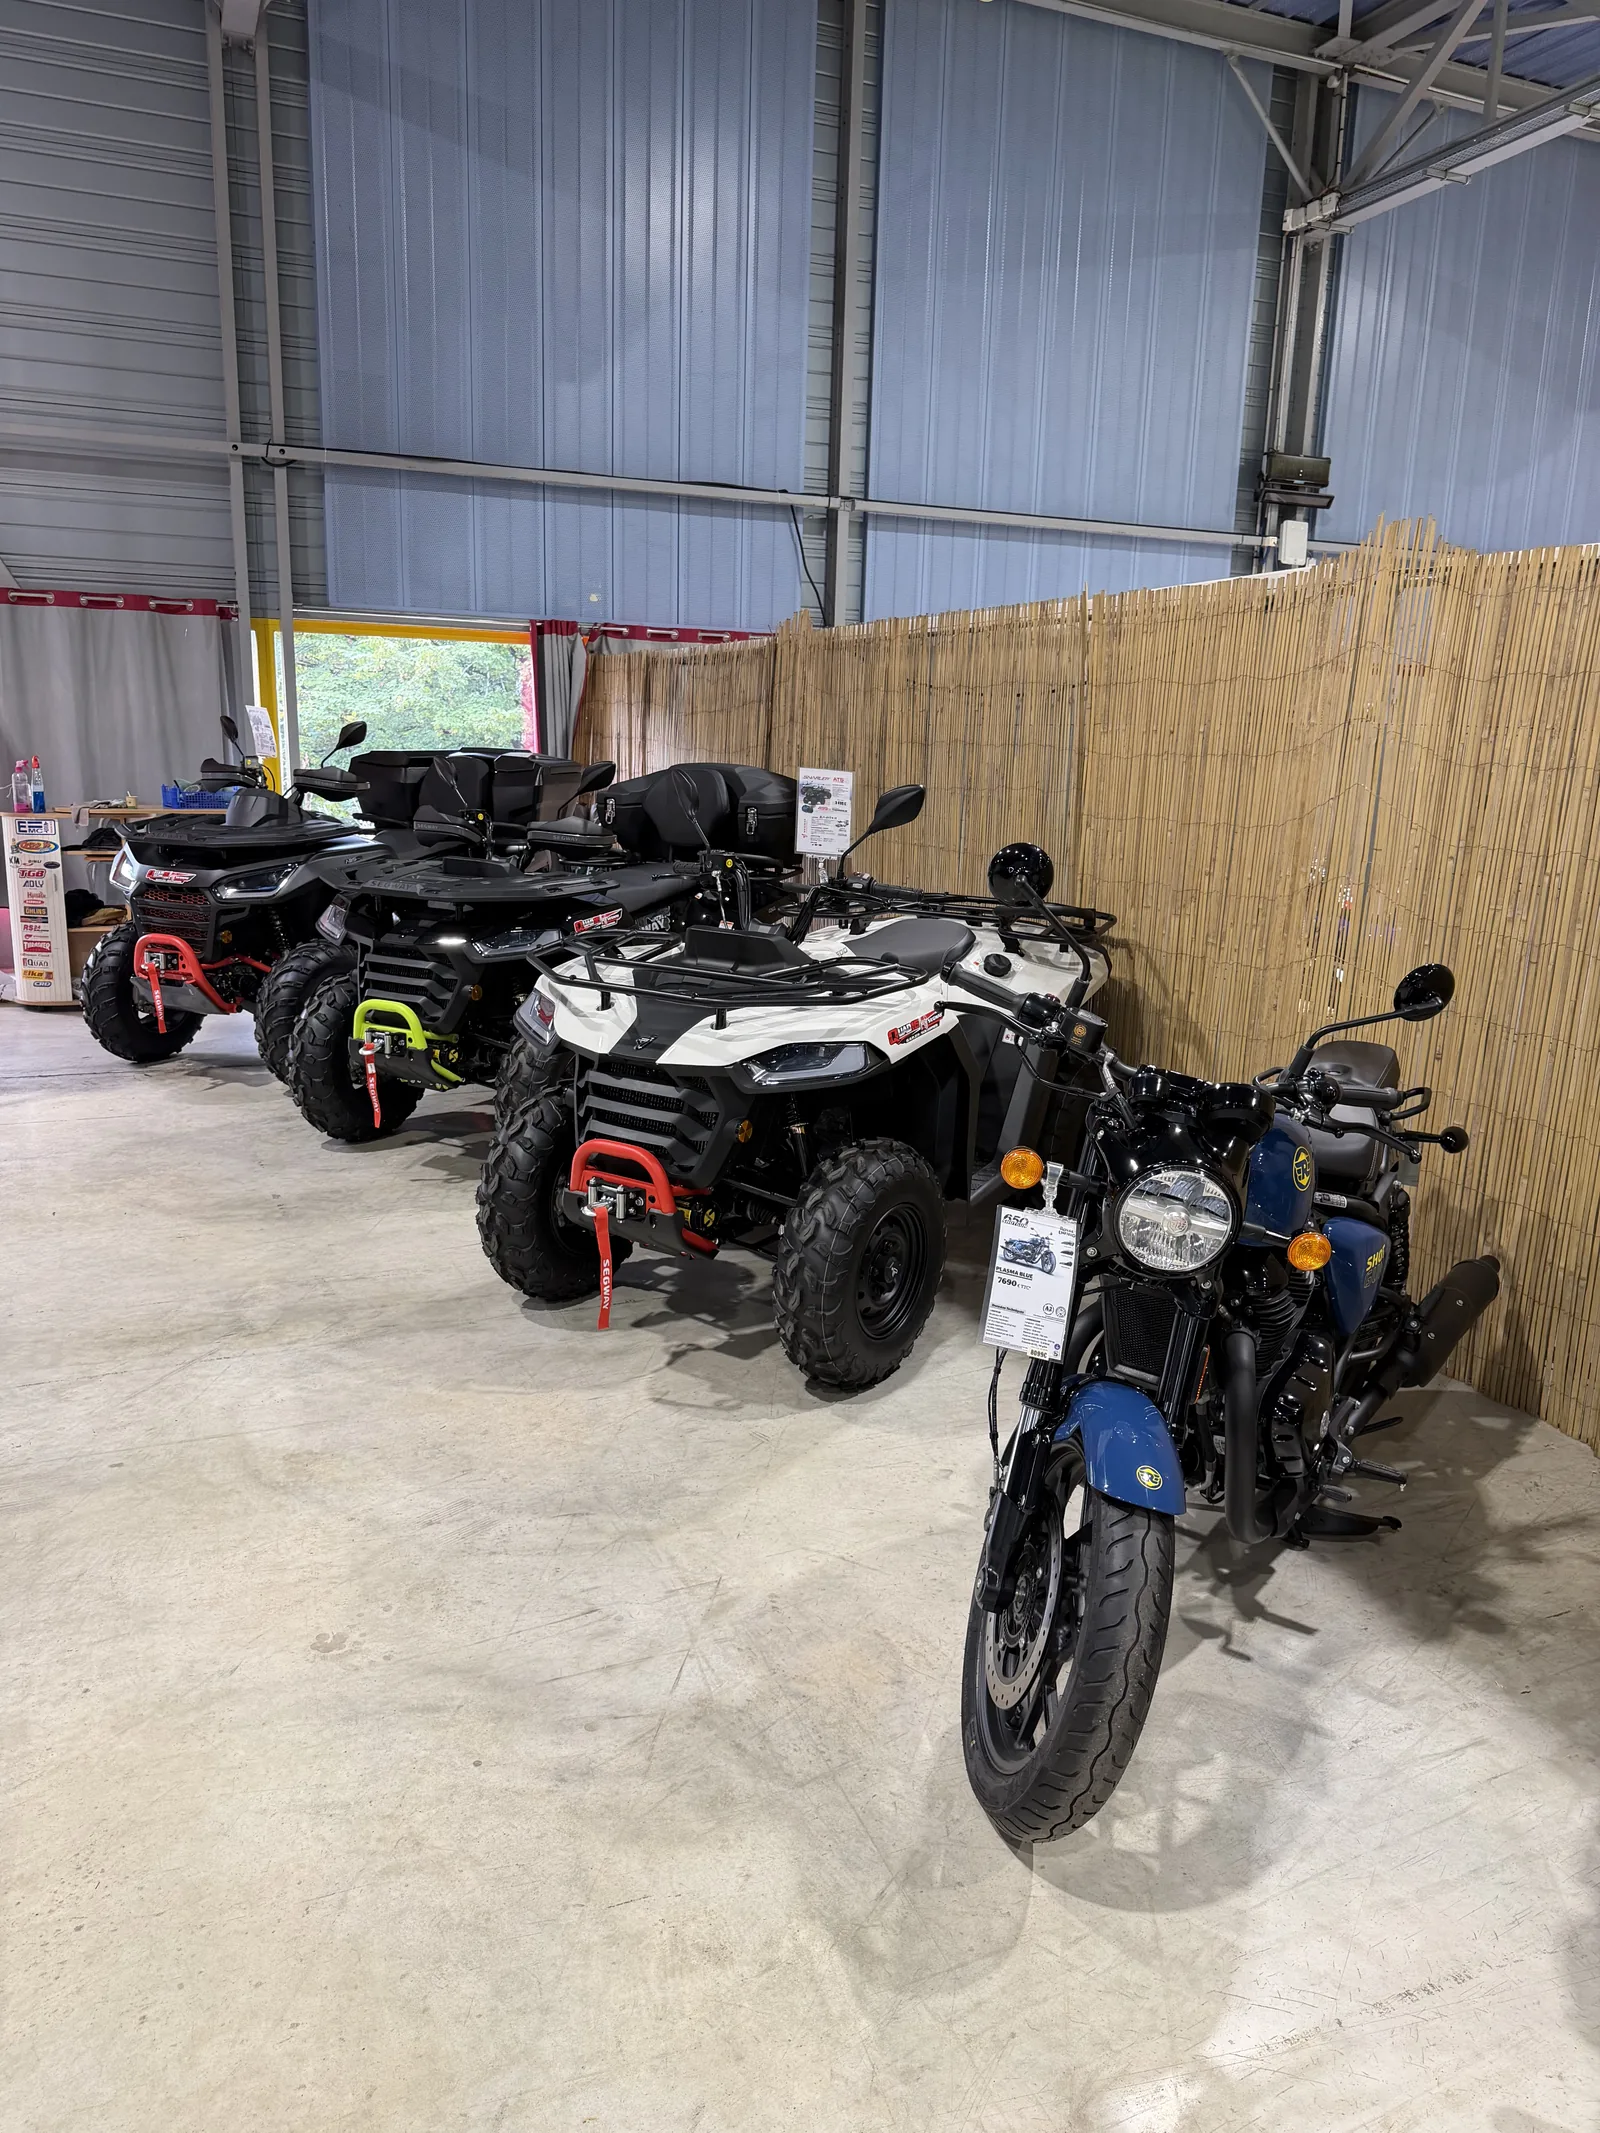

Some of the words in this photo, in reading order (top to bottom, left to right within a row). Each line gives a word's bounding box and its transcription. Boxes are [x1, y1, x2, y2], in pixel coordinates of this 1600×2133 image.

[552, 834, 579, 842] SEGWAY
[20, 869, 45, 877] TGB
[23, 880, 44, 888] ADLY
[154, 990, 163, 1020] SEGWAY
[369, 1077, 380, 1113] SEGWAY
[1003, 1213, 1029, 1225] 650
[996, 1266, 1019, 1277] PLASMA
[1019, 1270, 1033, 1279] BLUE
[602, 1258, 611, 1310] SEGWAY
[997, 1276, 1017, 1287] 7690
